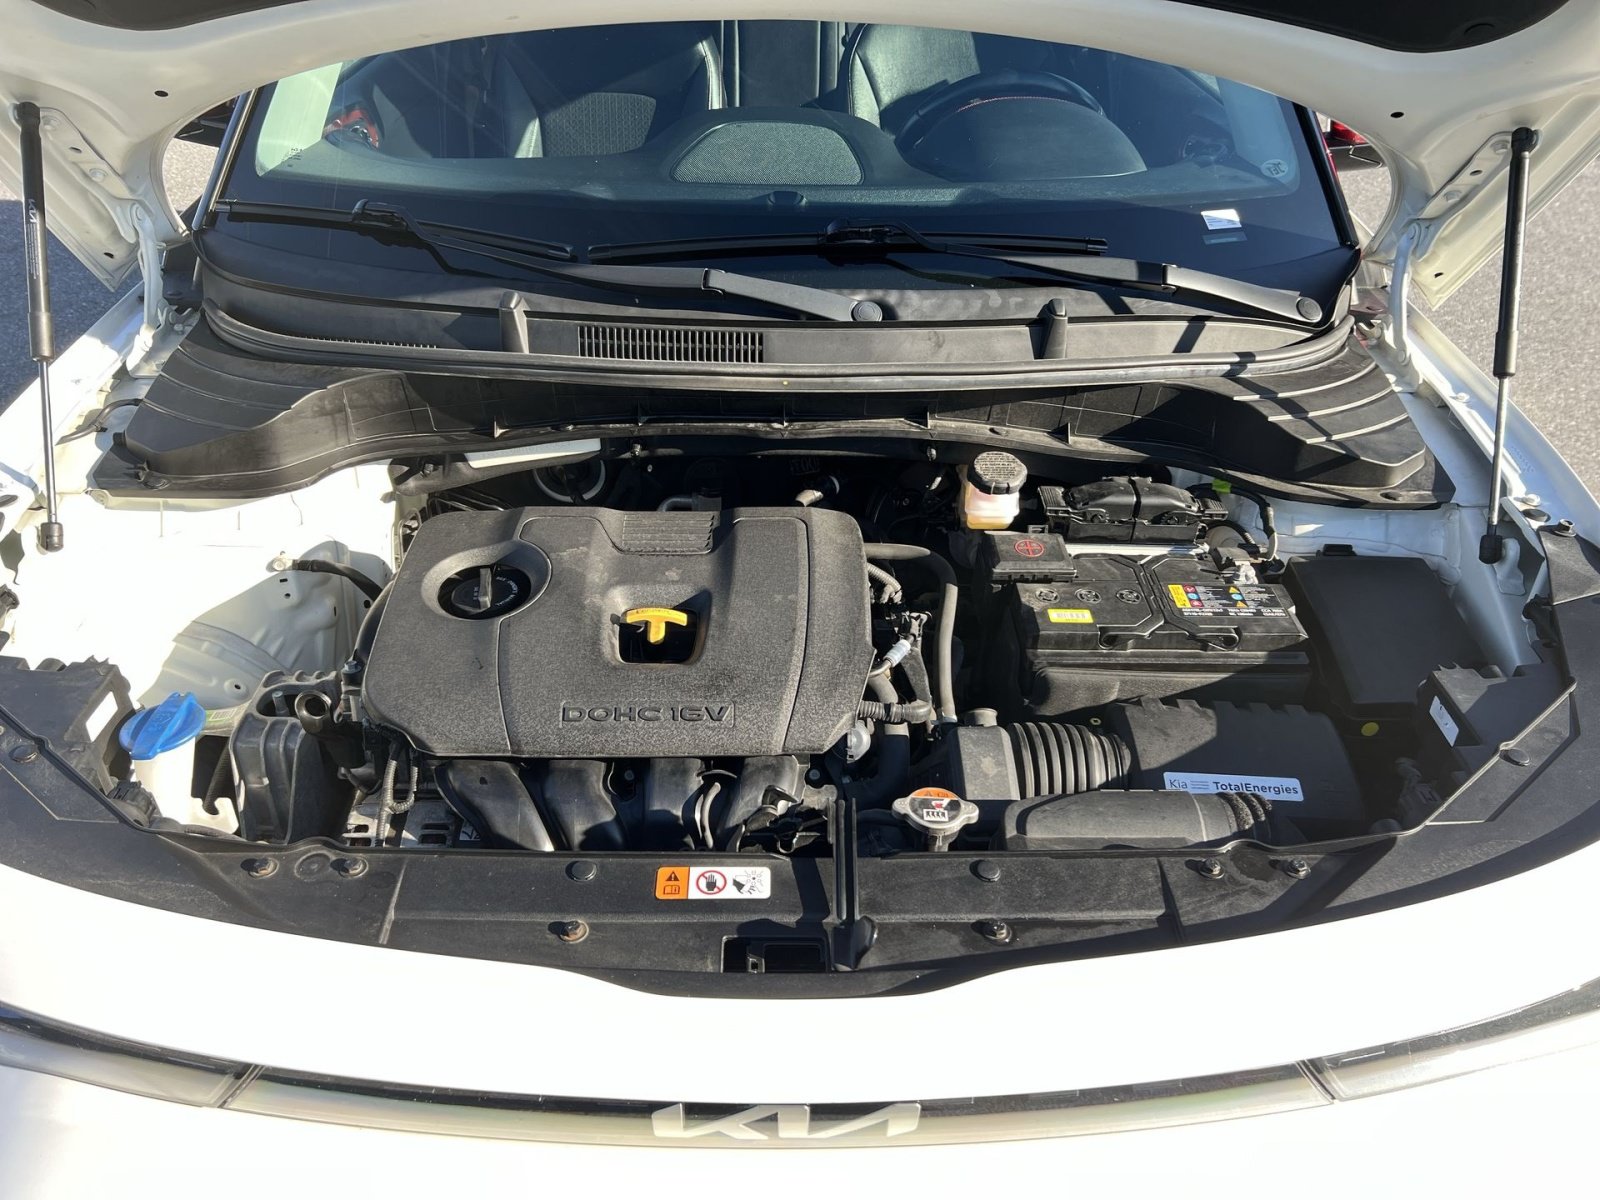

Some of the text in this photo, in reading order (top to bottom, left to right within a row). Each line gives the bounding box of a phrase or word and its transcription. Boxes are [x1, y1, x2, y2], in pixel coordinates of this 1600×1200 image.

[562, 706, 729, 722] DOHC 16V
[1169, 779, 1299, 795] Kia TotalEnergies
[651, 1101, 921, 1140] KIA
